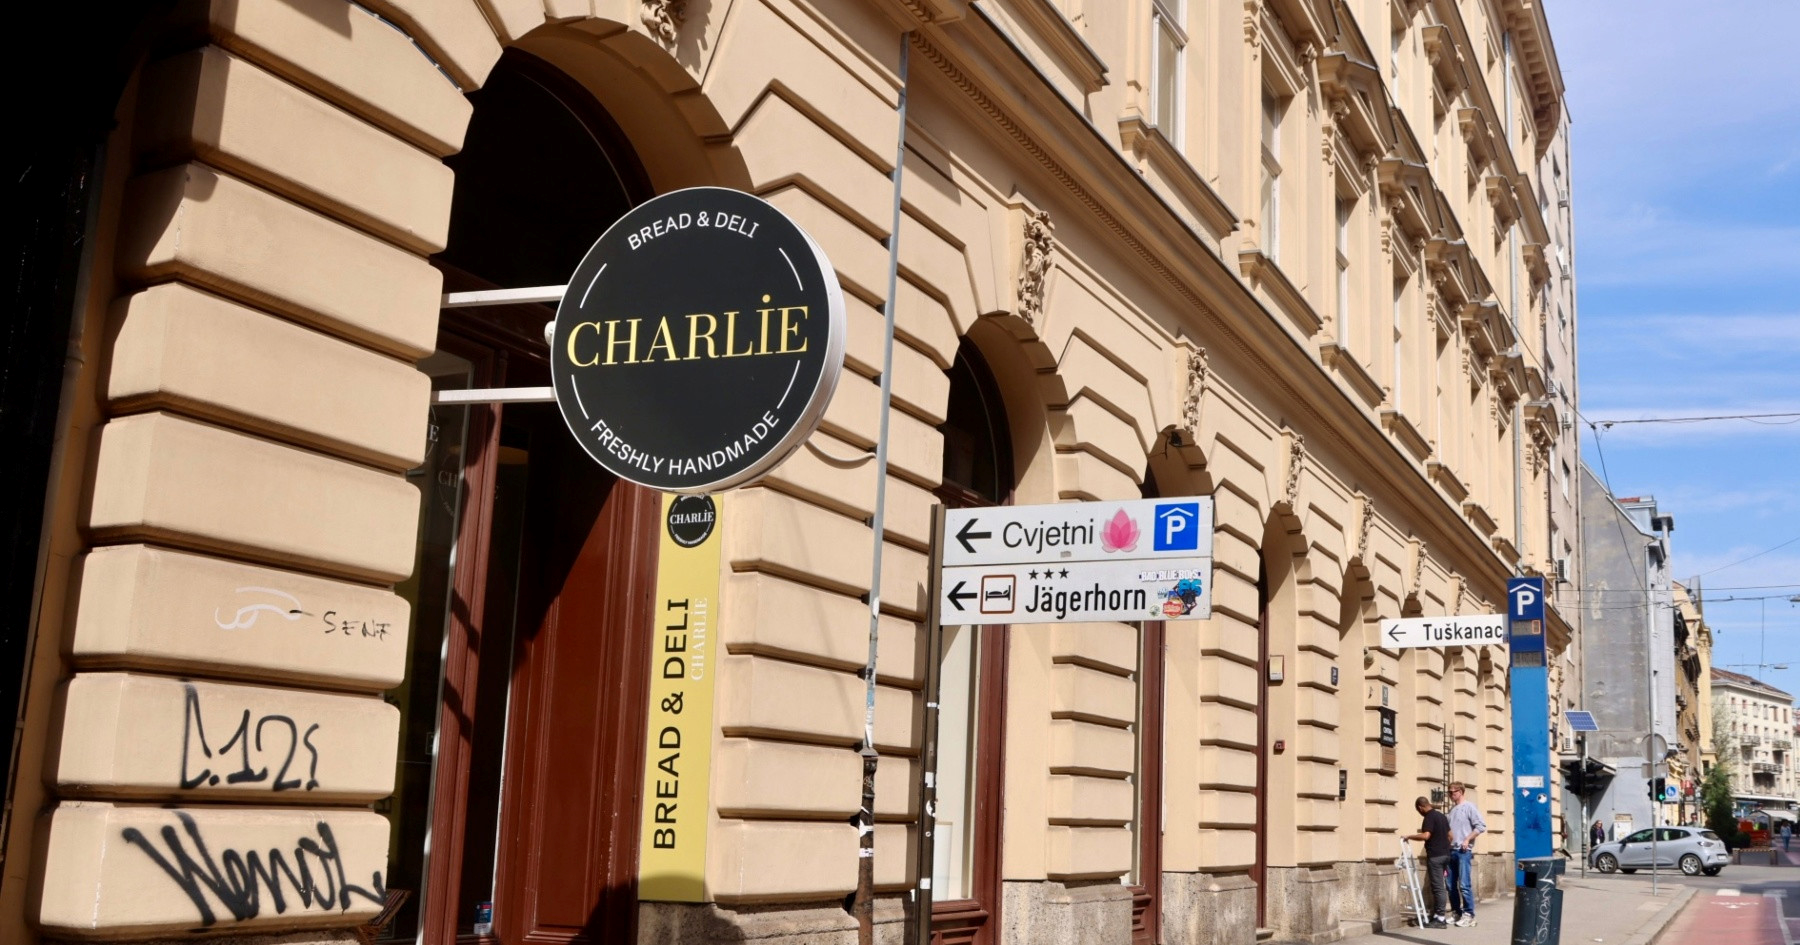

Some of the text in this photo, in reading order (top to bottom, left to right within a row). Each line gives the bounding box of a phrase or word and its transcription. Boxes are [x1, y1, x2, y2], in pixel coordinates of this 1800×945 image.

[627, 211, 760, 250] BREAD & DELI
[590, 409, 780, 476] FRESHLY HANDMADE
[1002, 518, 1095, 555] Cvjetni
[1165, 515, 1187, 545] P
[1025, 582, 1147, 620] Jägerhorn
[1516, 590, 1535, 616] P
[1422, 621, 1503, 641] Tuškanac
[653, 598, 689, 849] BREAD & DELI
